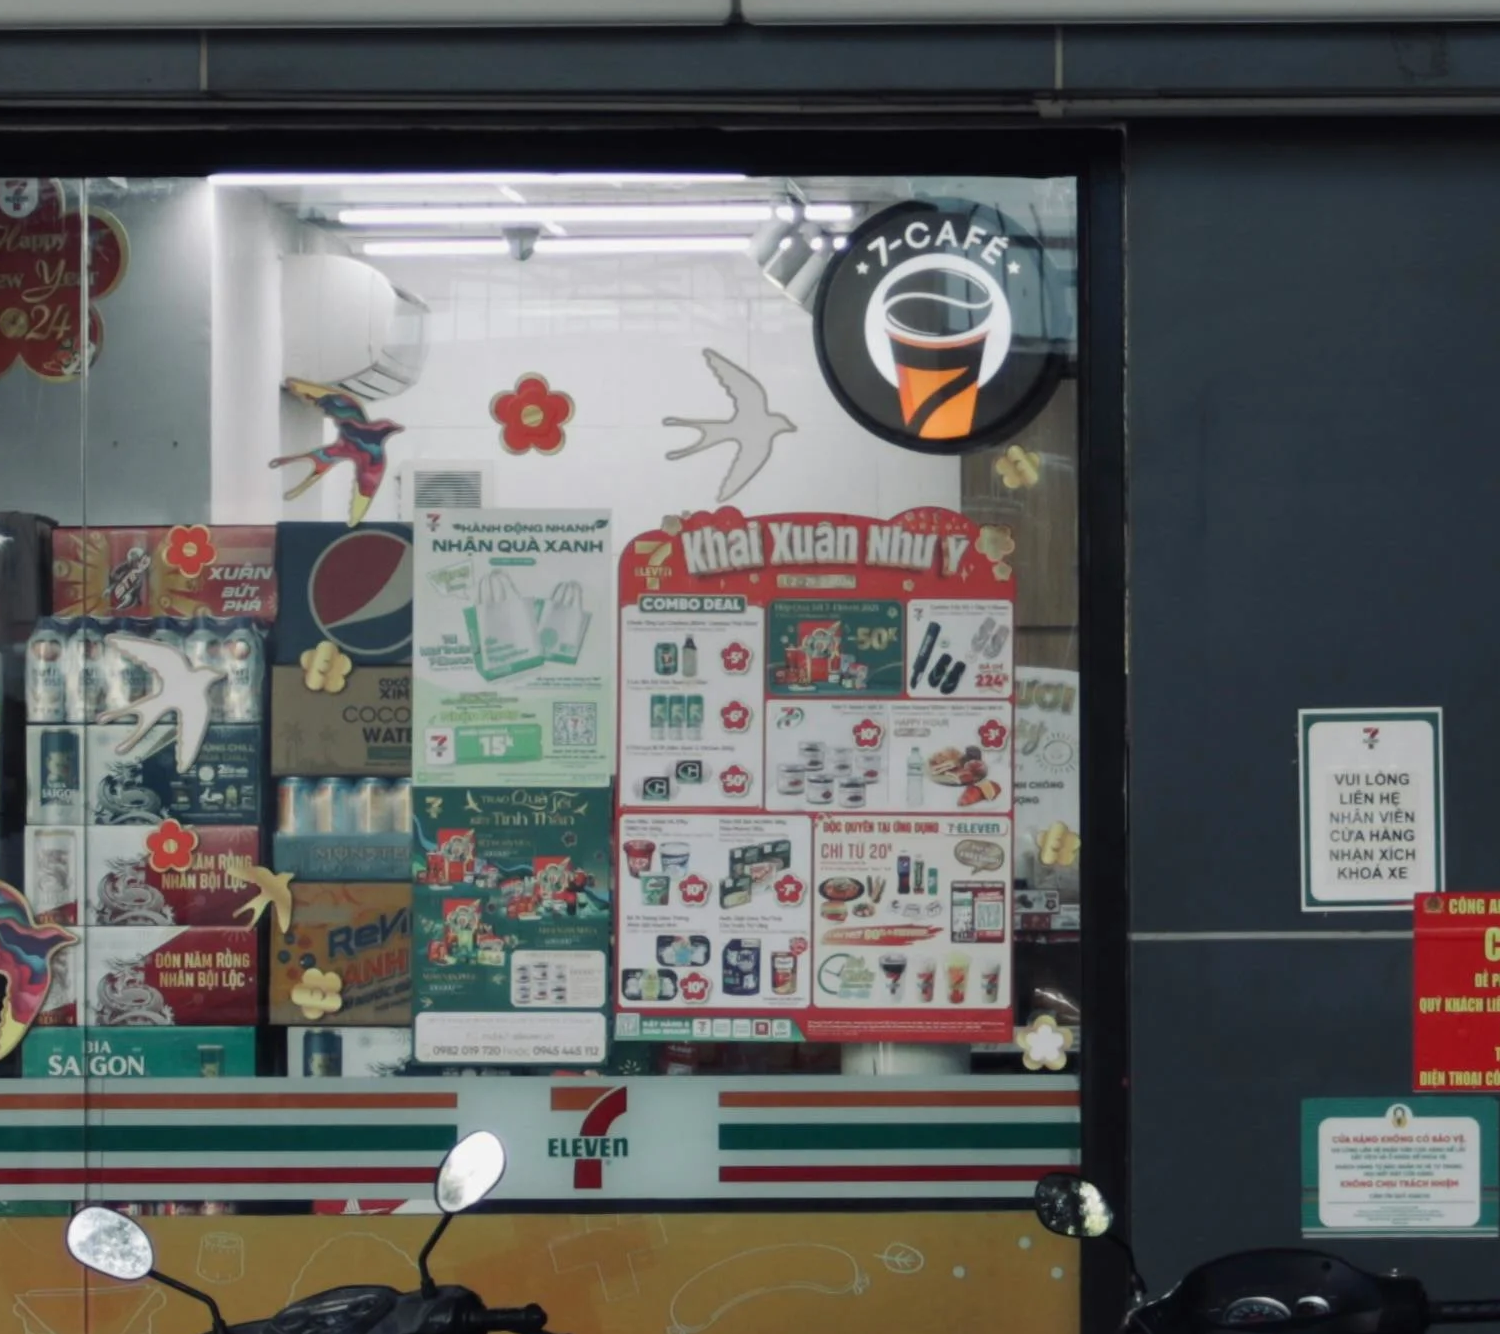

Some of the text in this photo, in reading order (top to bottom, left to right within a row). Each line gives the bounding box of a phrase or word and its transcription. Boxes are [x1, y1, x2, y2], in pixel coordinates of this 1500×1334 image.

[867, 220, 1009, 267] 7-CAFÉ
[432, 536, 604, 556] NHẬN QUÀ XANH
[680, 520, 764, 577] Khai
[769, 520, 858, 566] Xuân
[208, 561, 273, 581] XUÂN
[642, 597, 741, 610] COMBO DEAL
[1334, 769, 1411, 786] VUI LÒNG
[1339, 789, 1401, 807] LIÊN HỆ
[1329, 807, 1416, 824] NHÂN VIÊN
[1337, 863, 1408, 880] KHOÁ XE
[1449, 896, 1485, 915] CÔNG
[158, 969, 196, 988] NHÂN
[1445, 995, 1484, 1013] KHÁCH
[550, 1086, 627, 1189] 7
